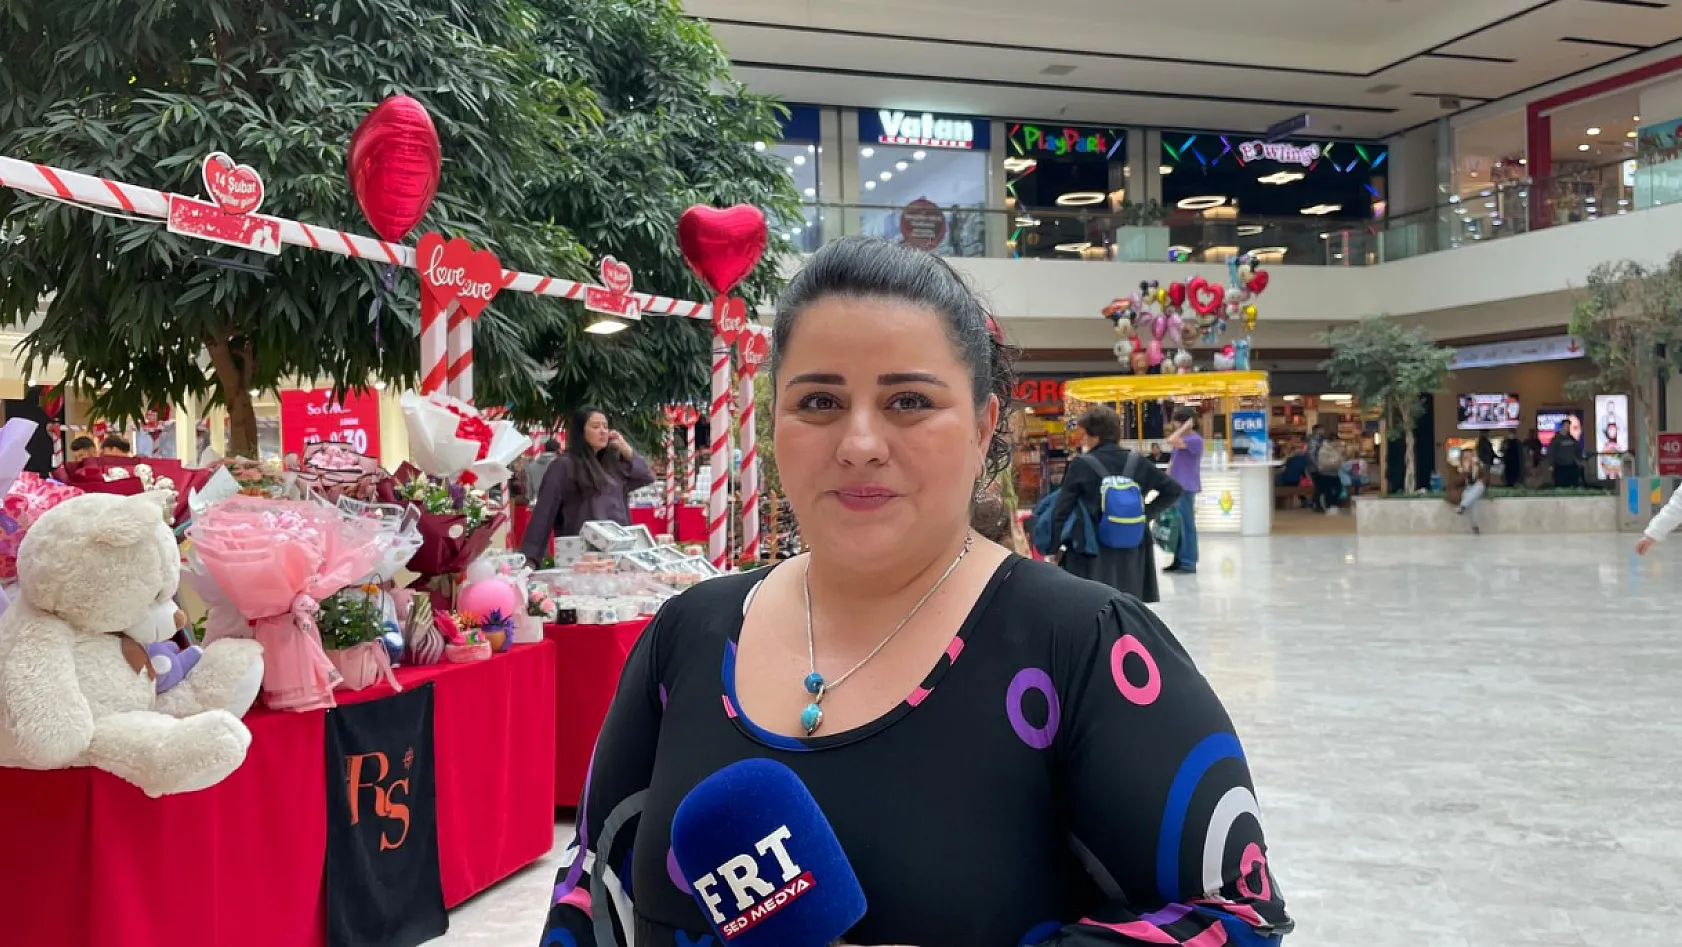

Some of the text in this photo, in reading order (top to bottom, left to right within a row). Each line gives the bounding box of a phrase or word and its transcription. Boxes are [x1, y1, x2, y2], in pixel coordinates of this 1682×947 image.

[878, 110, 974, 142] Vatan
[215, 171, 256, 193] 14 Şubat
[423, 245, 465, 286] love
[693, 824, 802, 925] FRT
[723, 878, 810, 936] SED MEDYA
